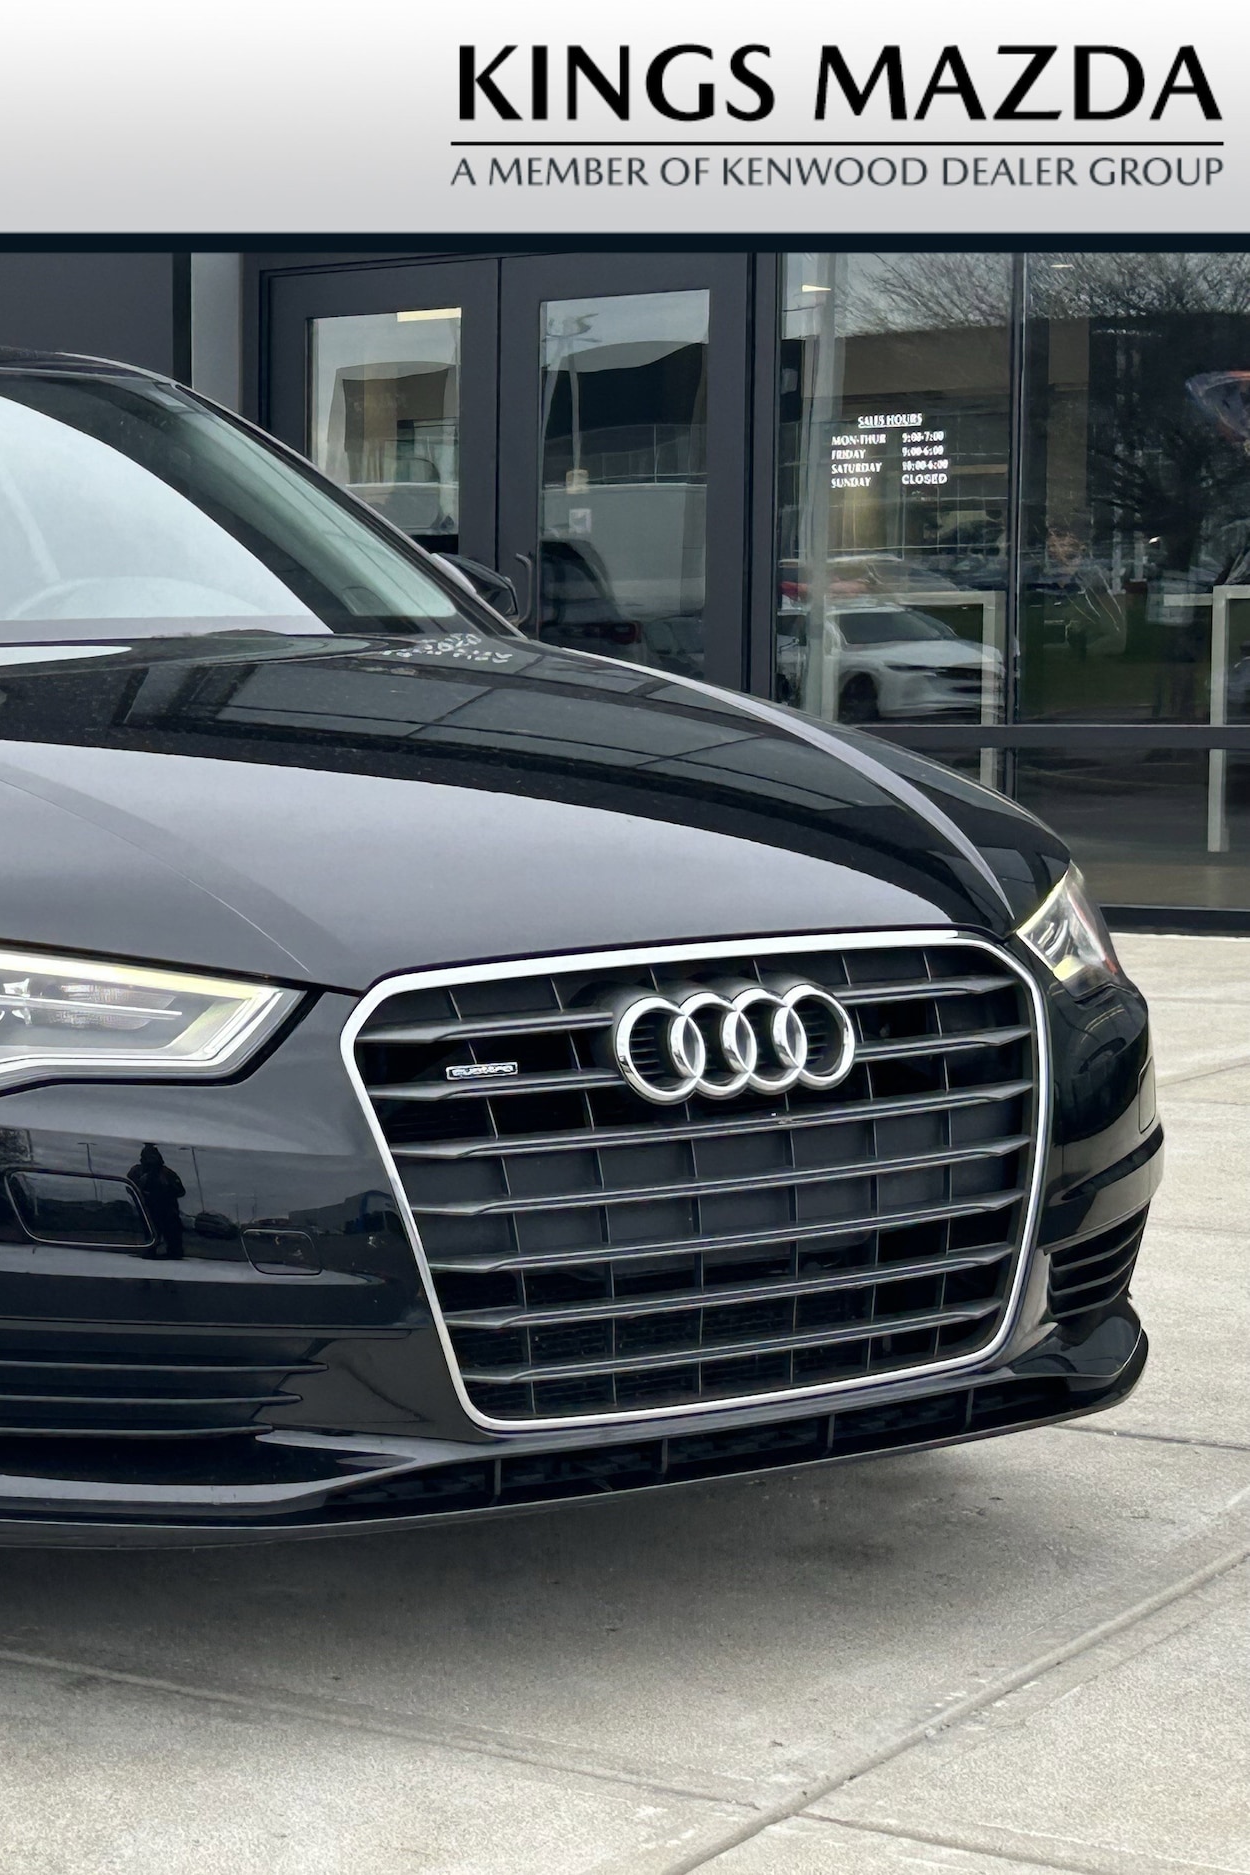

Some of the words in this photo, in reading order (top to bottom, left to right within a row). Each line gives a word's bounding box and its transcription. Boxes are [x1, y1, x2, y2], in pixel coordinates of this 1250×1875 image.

[886, 413, 922, 426] HOURS
[831, 449, 866, 460] FRIDAY
[831, 462, 882, 474] SATURDAY
[831, 476, 871, 489] SUNDAY
[901, 473, 948, 485] CLOSED
